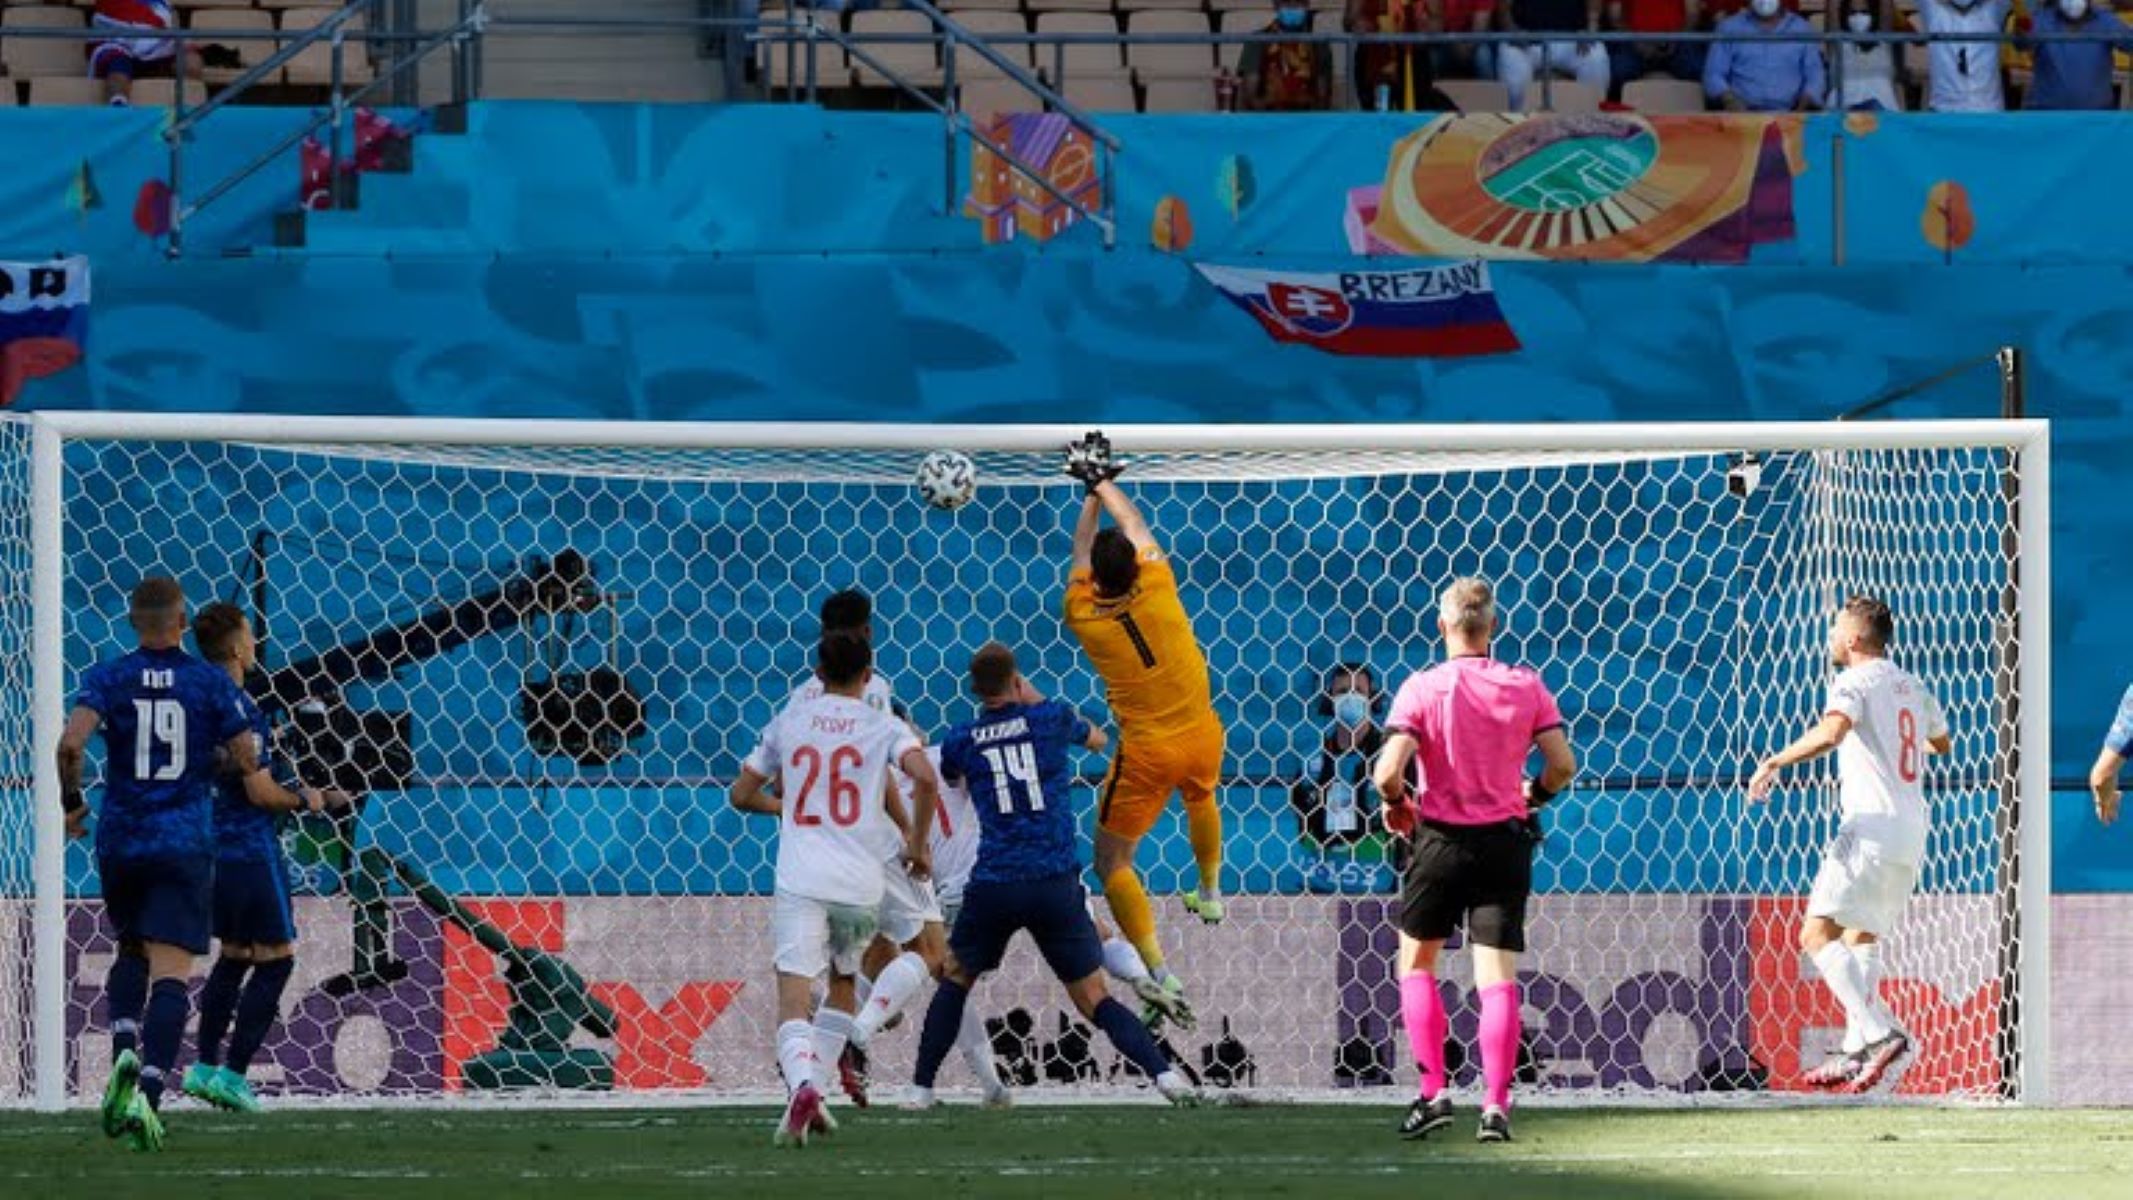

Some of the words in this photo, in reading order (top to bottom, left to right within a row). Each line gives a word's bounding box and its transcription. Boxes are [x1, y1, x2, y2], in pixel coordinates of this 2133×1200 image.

[1114, 611, 1158, 669] 1
[132, 699, 187, 780] 19
[1898, 707, 1917, 782] 8
[791, 745, 863, 827] 26
[980, 742, 1047, 815] 14
